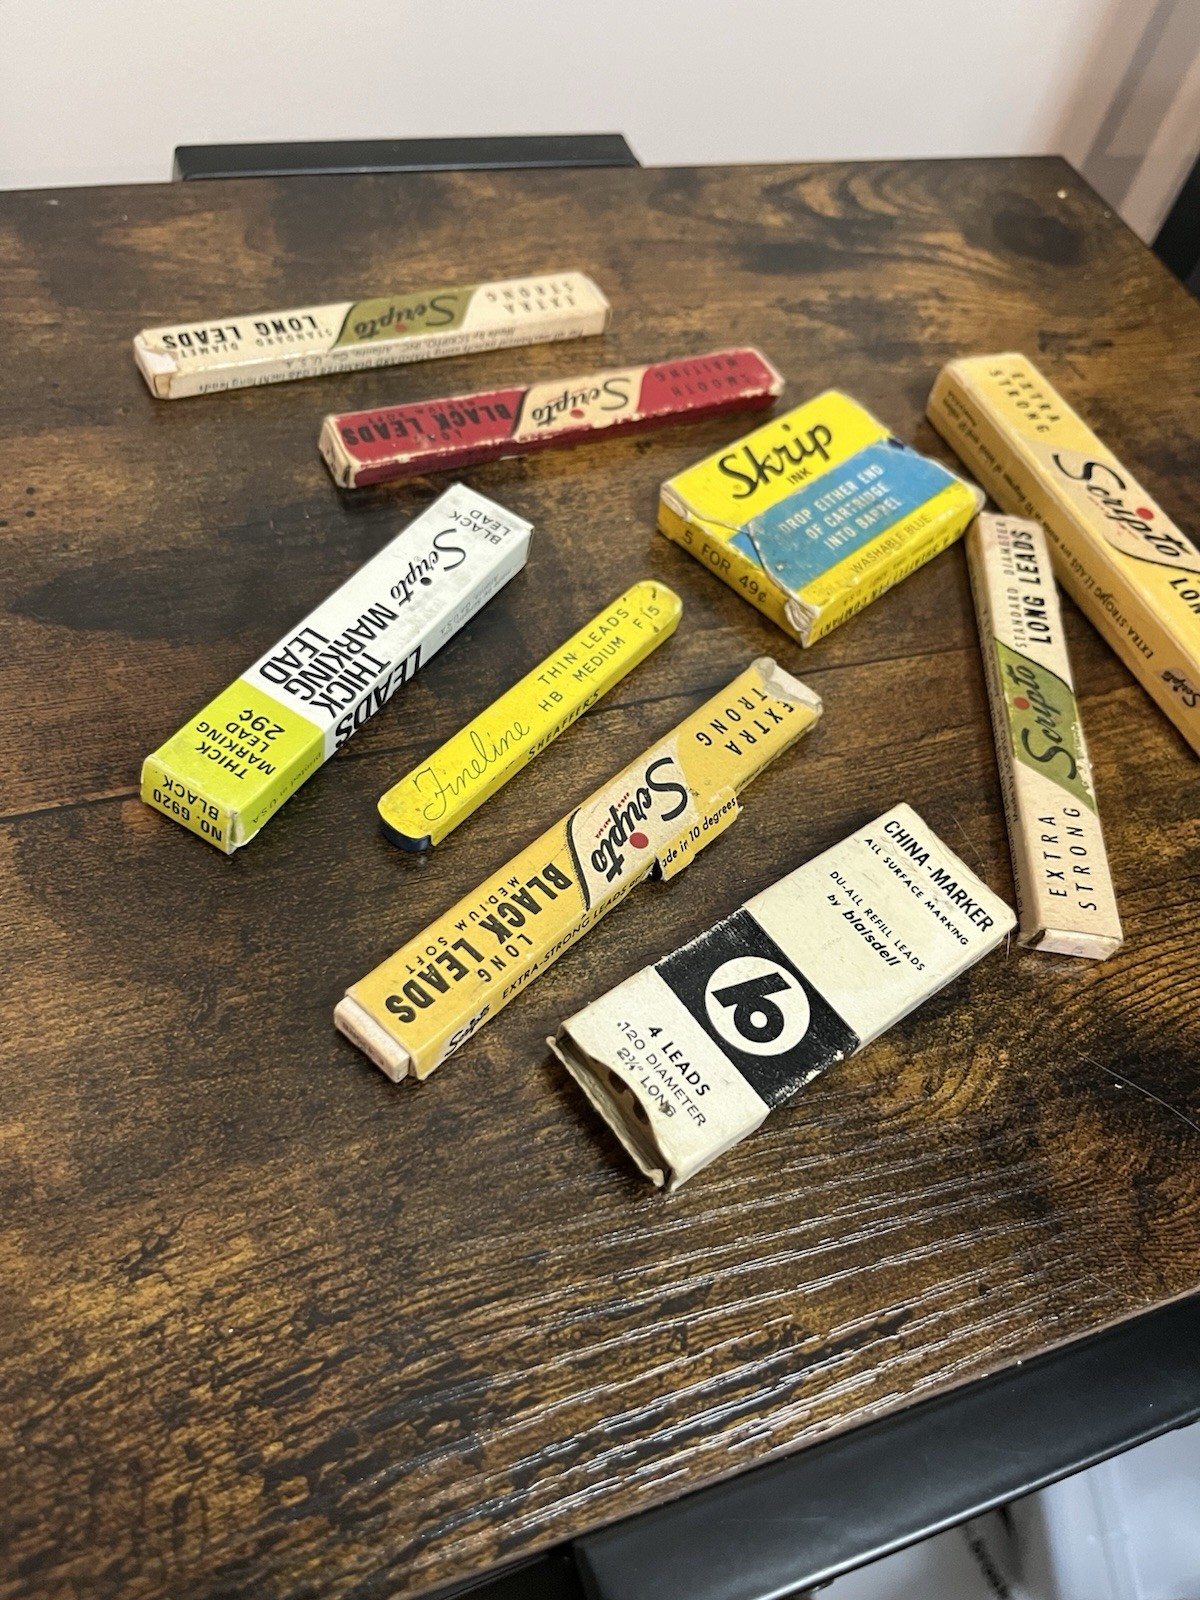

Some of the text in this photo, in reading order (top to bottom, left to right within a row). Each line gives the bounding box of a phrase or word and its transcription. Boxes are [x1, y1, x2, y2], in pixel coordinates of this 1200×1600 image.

[354, 297, 455, 339] Scripto
[486, 280, 571, 301] STRONG
[162, 316, 317, 349] LONG LEADS
[177, 340, 239, 357] DIAMET
[341, 404, 513, 446] BLACK LEADS
[532, 379, 630, 427] Scripto
[990, 370, 1047, 433] STRONG
[1012, 373, 1060, 422] EXTRA
[718, 424, 832, 499] Skrip
[787, 467, 812, 485] INK
[449, 510, 502, 545] BLACK
[470, 510, 511, 536] LEAD
[778, 465, 883, 533] DROP EITHER END
[805, 481, 890, 539] OF CARTRIDGE
[823, 496, 902, 550] INTO BARREL
[1052, 454, 1191, 558] Scripto
[390, 528, 466, 607] Scripto
[683, 530, 767, 603] 5 FOR 49¢
[849, 534, 906, 576] WASHABLE
[908, 514, 933, 538] BLUE
[1067, 556, 1096, 588] LEADS
[994, 521, 1028, 649] STANDARD DIAMETER
[1013, 530, 1052, 644] LONG LEADS
[259, 627, 330, 684] LEAD
[283, 602, 399, 701] MARKING
[537, 608, 629, 685] THIN LEADS
[538, 691, 563, 712] HB
[572, 636, 626, 682] MEDIUM
[310, 652, 391, 719] THICK
[335, 645, 422, 748] LEADS
[696, 688, 768, 746] TRONG
[1161, 671, 1200, 707] Scripto
[196, 722, 276, 775] MARKING
[226, 722, 269, 753] LEAD
[239, 709, 284, 740] 29¢
[724, 701, 794, 755] EXTRA
[1006, 664, 1076, 780] Scripto
[195, 741, 248, 779] THICK
[412, 722, 530, 821] Fineline
[162, 775, 219, 820] BLACK
[195, 816, 222, 842] NO.
[591, 757, 689, 882] Scripto
[884, 820, 994, 932] CHINA-MARKER
[1038, 817, 1067, 897] EXTRA
[1063, 808, 1097, 911] STRONG
[502, 916, 590, 1000] EXTRA-STRONG
[592, 887, 627, 916] LEADS
[662, 848, 678, 868] ade
[689, 826, 700, 842] 10
[702, 796, 737, 831] degrees
[830, 871, 925, 971] DU-ALL REFILL LEADS
[864, 839, 969, 945] ALL SURFACE MARKING
[385, 862, 573, 1023] BLACK LEADS
[405, 876, 520, 974] MEDIUM SOFT
[827, 894, 901, 966] by blaisdell
[477, 933, 533, 982] LONG
[617, 1022, 706, 1127] .120 DIAMETER
[648, 1027, 710, 1096] 4 LEADS
[640, 1076, 676, 1118] LONG
